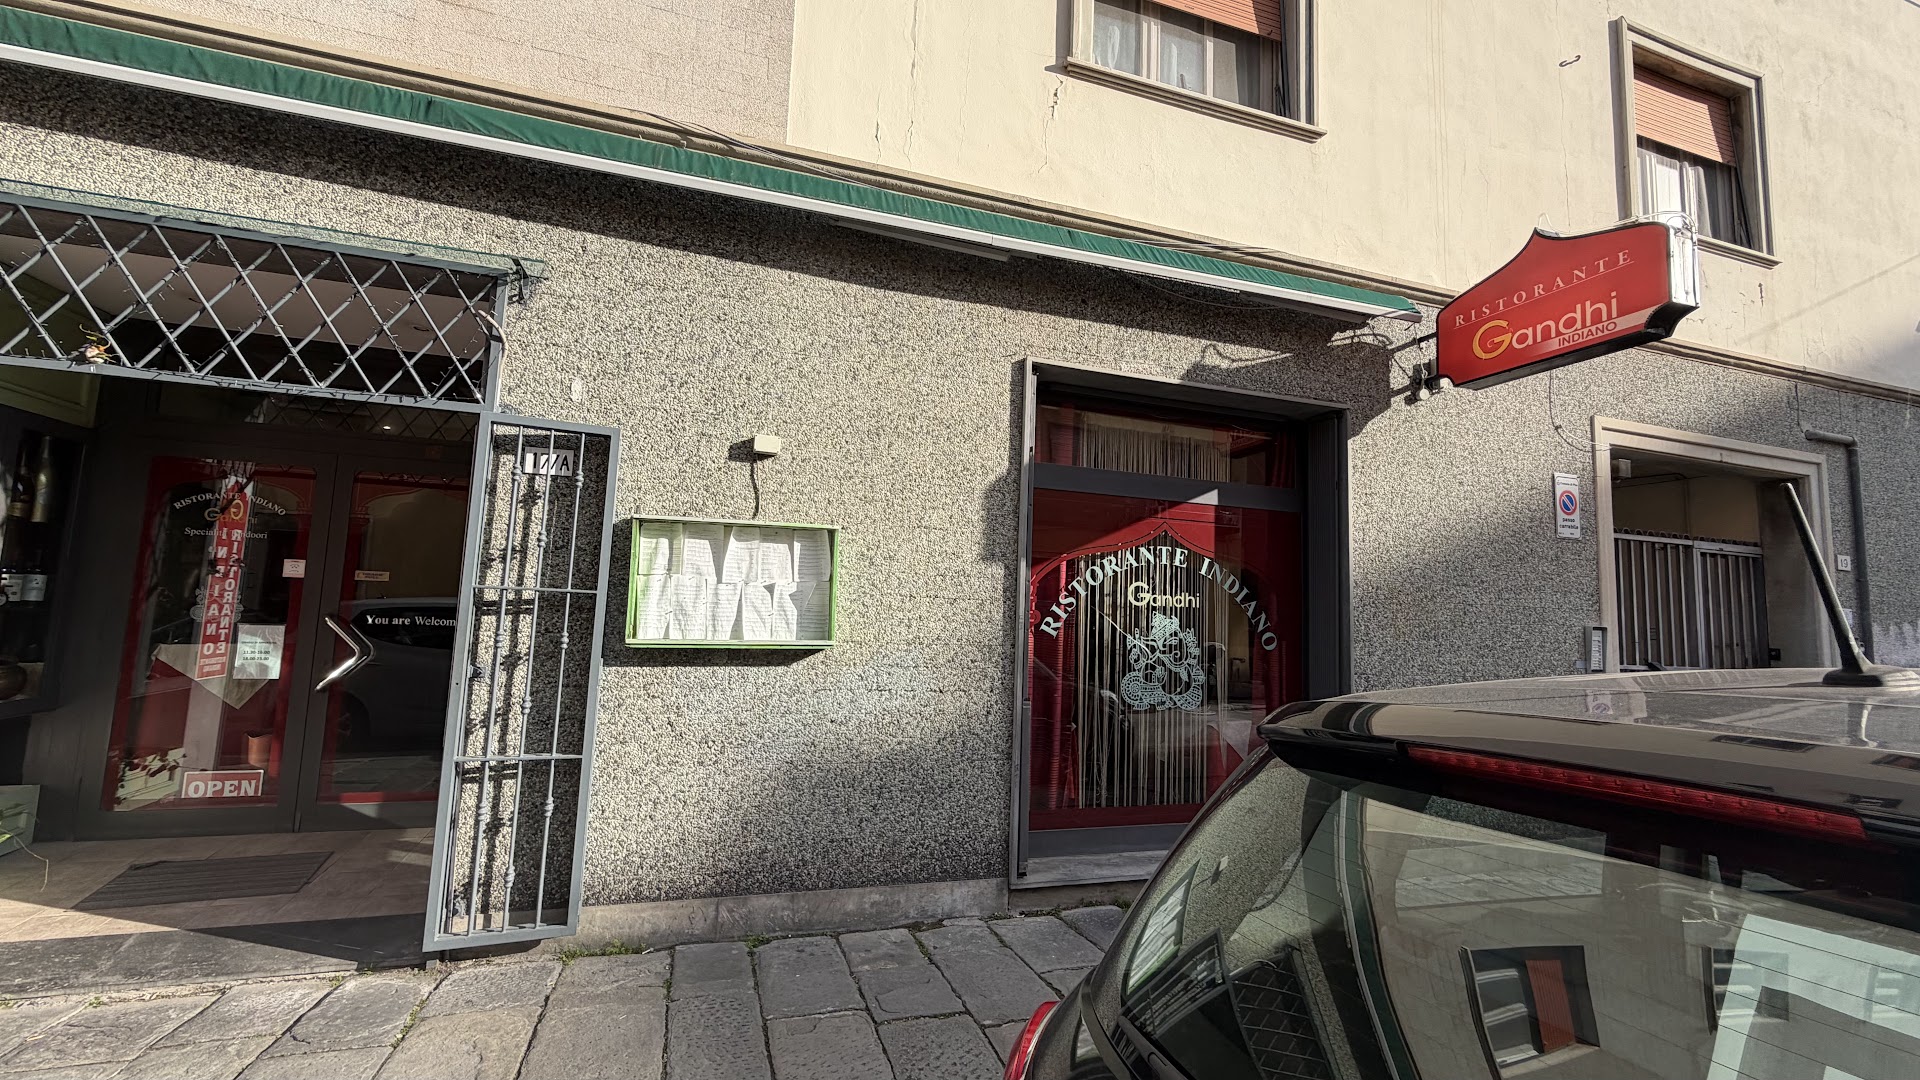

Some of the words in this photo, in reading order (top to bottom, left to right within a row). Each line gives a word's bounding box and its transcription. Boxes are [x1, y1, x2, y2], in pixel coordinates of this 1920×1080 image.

[1455, 250, 1631, 327] RISTORANTE
[1472, 291, 1617, 360] Gandhi
[1558, 321, 1617, 348] INDIANO
[173, 492, 241, 510] RISTORANTE
[246, 495, 286, 516] INDIANO
[204, 507, 257, 524] Ganhi
[184, 527, 228, 538] Specialit
[230, 529, 268, 540] Tndoori
[1040, 546, 1188, 639] RISTORANTE
[1198, 556, 1278, 651] INDIANO
[1128, 581, 1200, 608] Gandhi
[366, 614, 389, 625] You
[391, 617, 411, 626] are
[415, 615, 456, 627] Welcom
[187, 780, 257, 798] OPEN
